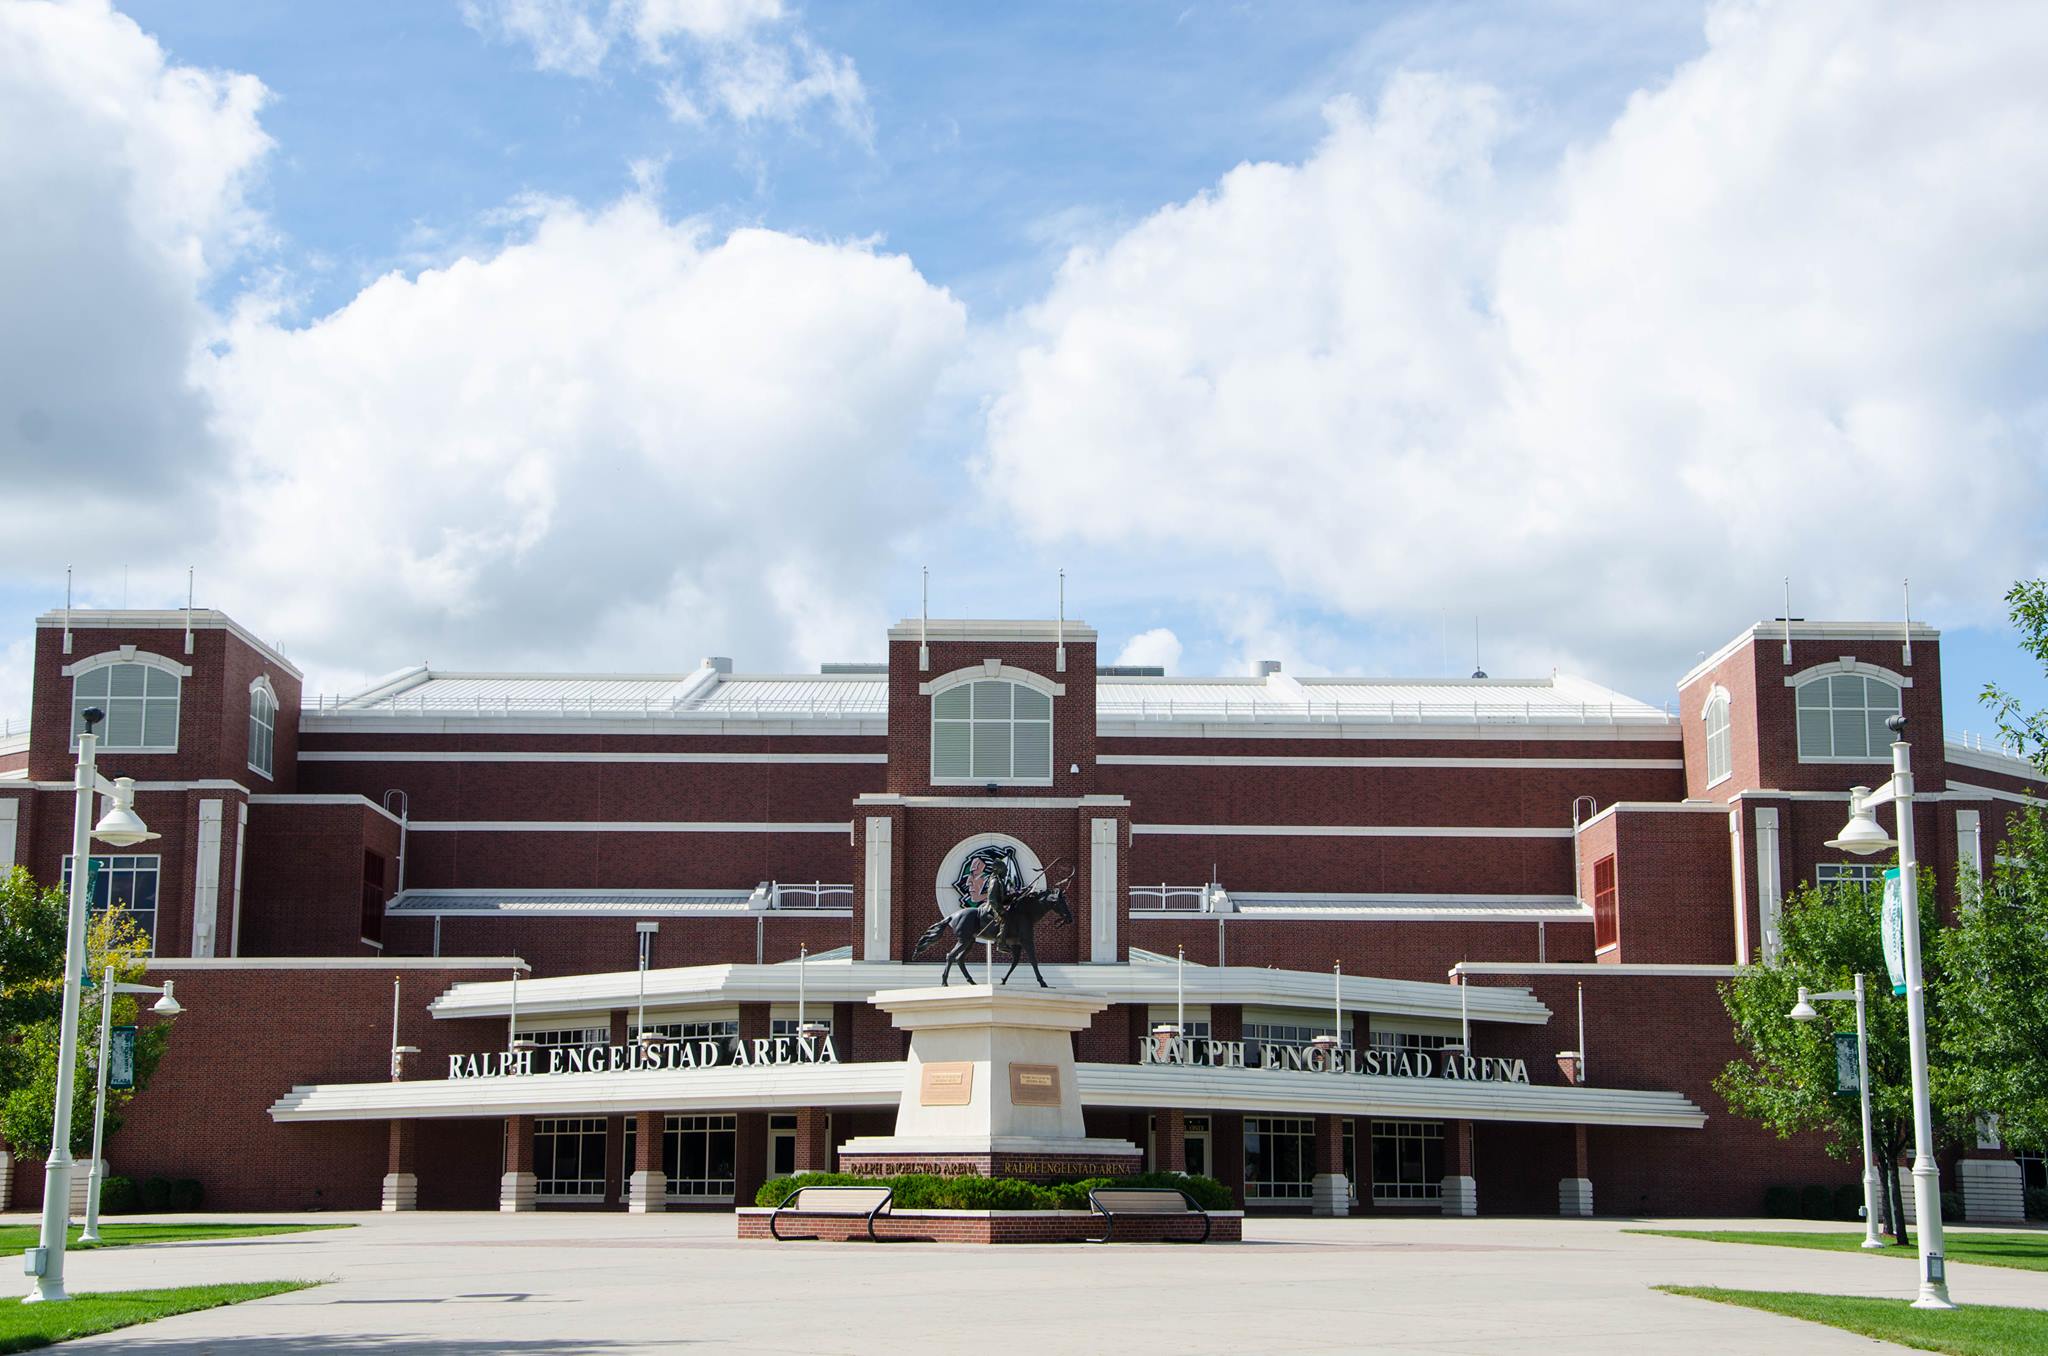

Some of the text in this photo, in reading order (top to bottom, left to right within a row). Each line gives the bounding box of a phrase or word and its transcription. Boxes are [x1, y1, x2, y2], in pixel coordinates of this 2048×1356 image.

[448, 1034, 838, 1079] RALPH ENGELSTAD ARENA
[1139, 1036, 1530, 1084] RALPH ENGELSTAD ARENA
[850, 1162, 979, 1175] RALPH ENGELSTAD ARENA
[1004, 1162, 1131, 1176] RALPH ENGELSTAD ARENA
